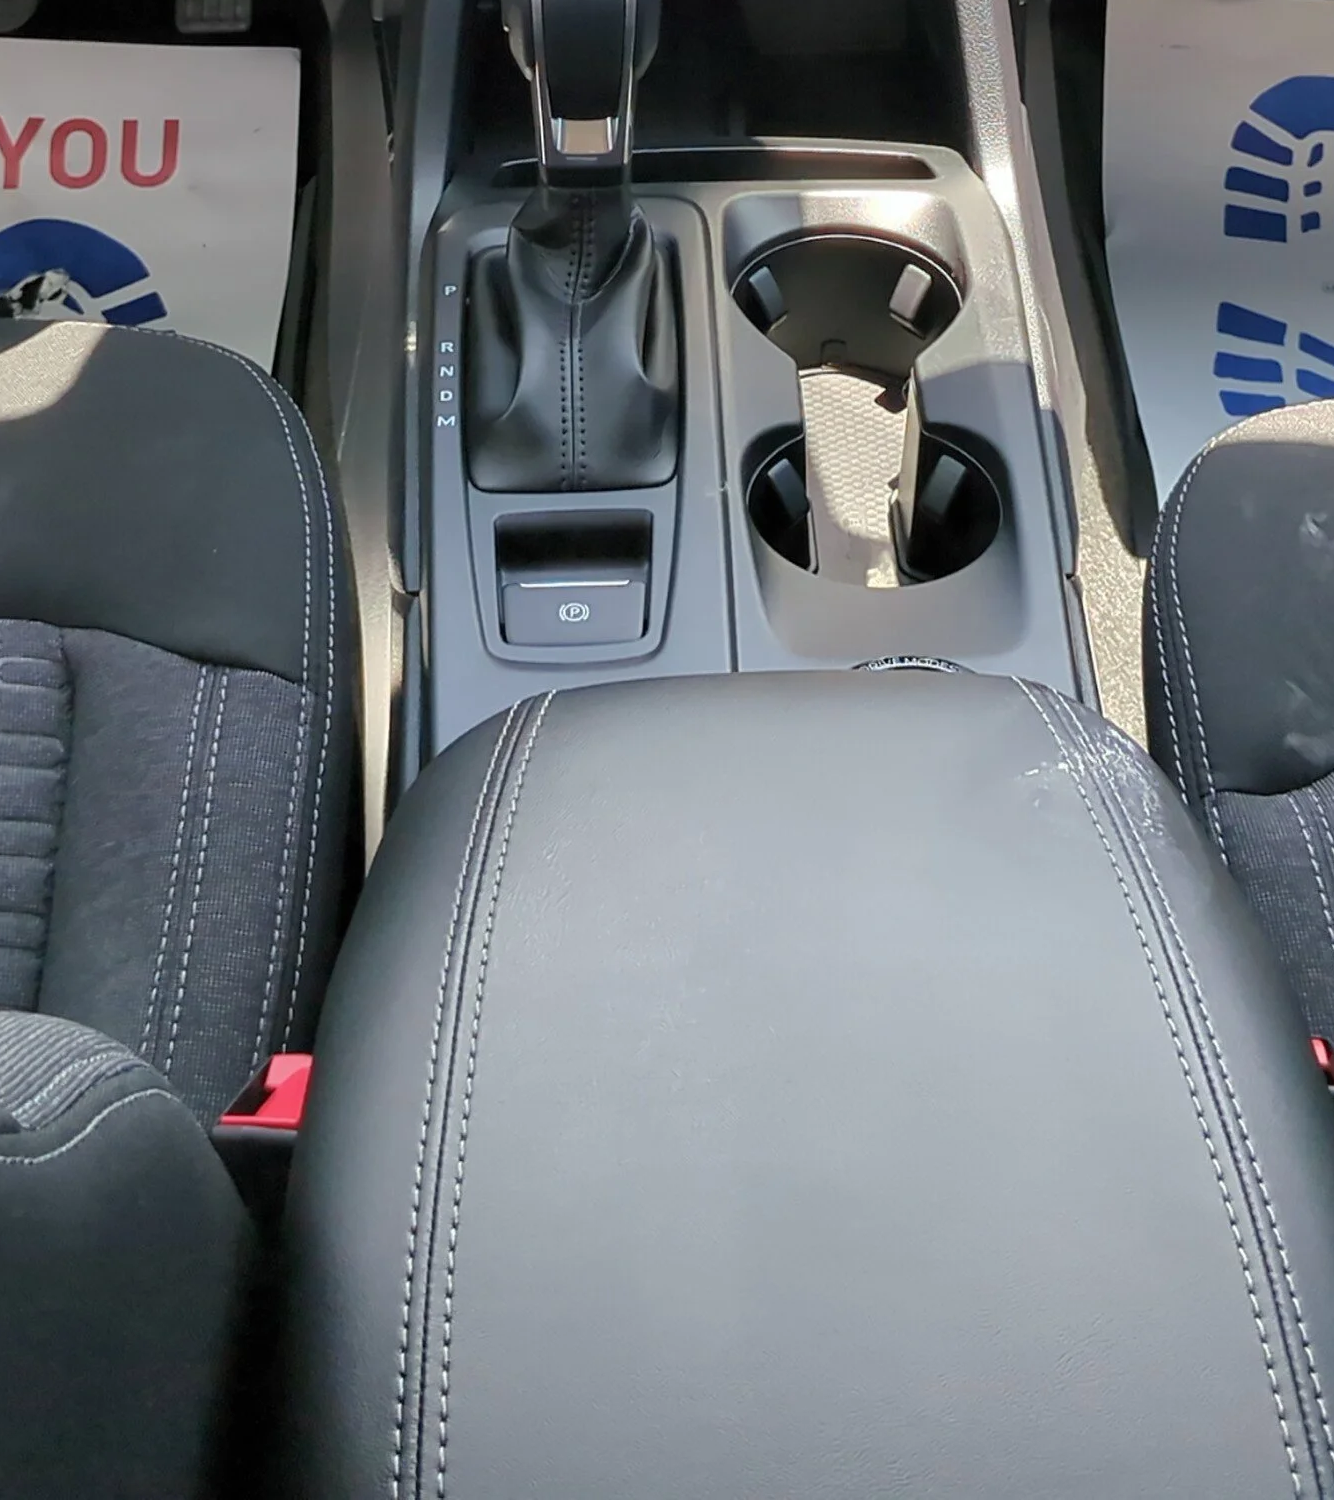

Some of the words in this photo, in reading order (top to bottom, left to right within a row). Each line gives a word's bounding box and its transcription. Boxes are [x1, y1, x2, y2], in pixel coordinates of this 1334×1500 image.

[443, 285, 458, 297] P
[440, 342, 455, 353] R
[439, 365, 455, 377] N
[439, 390, 454, 402] D
[437, 415, 456, 427] M
